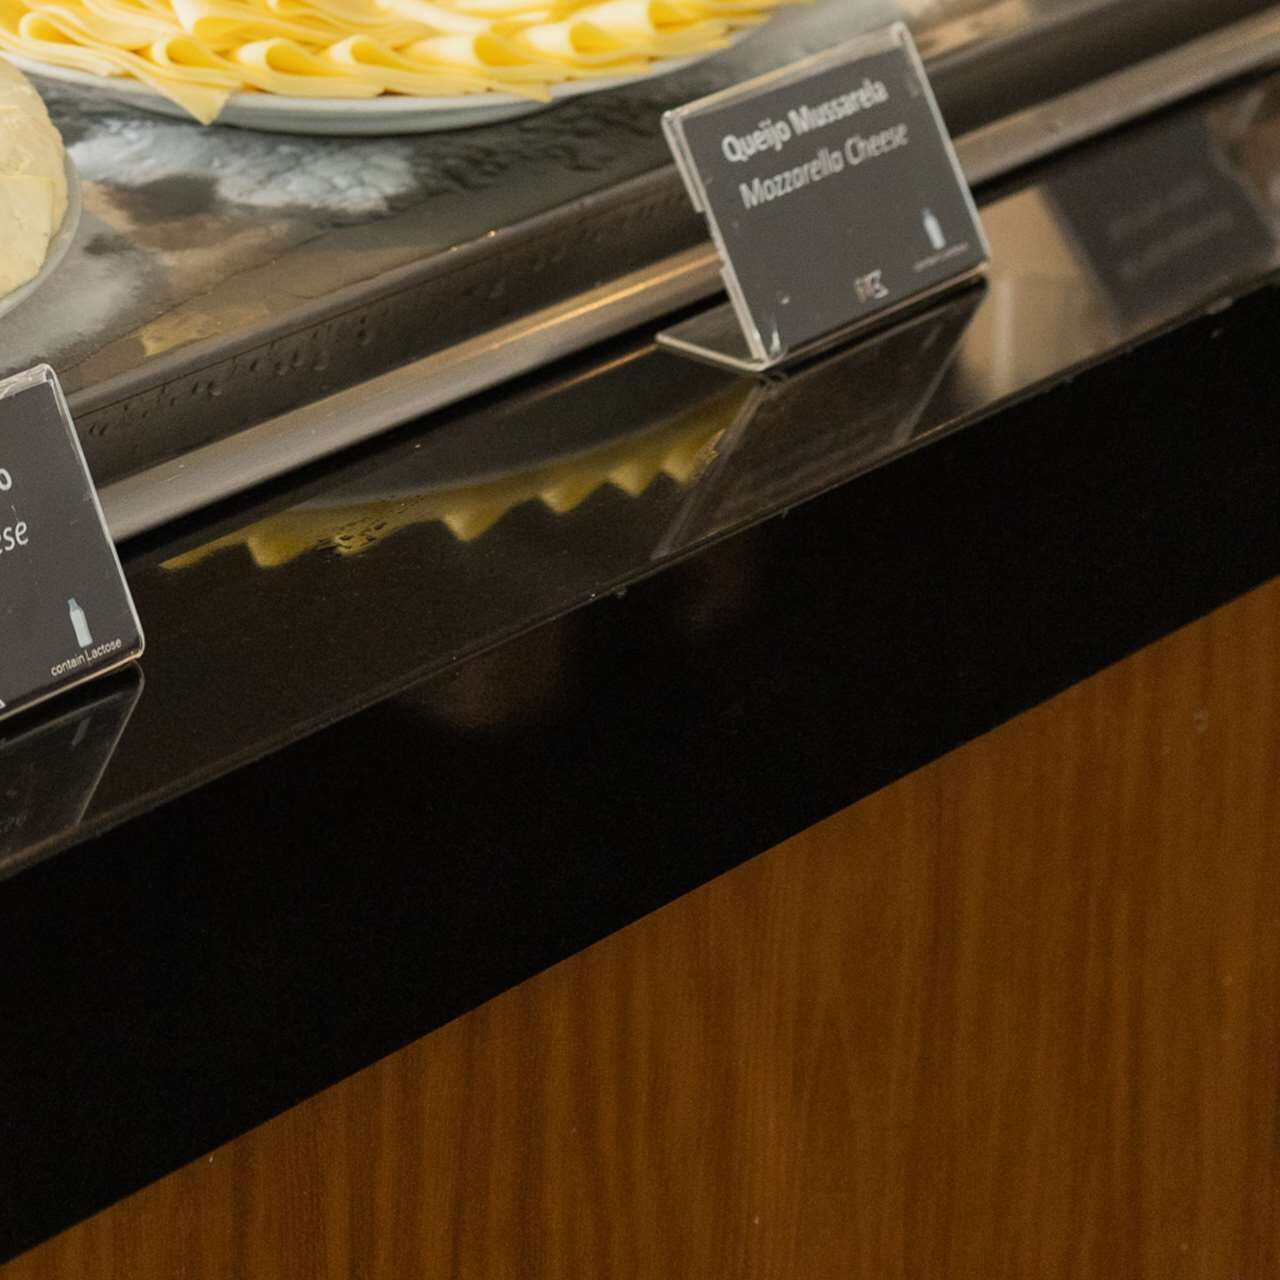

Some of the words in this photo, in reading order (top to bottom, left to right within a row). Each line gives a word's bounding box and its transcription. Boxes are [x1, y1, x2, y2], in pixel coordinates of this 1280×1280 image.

[721, 117, 792, 162] Queijo
[788, 78, 889, 136] Mussarela
[738, 146, 845, 210] Mozzarella
[845, 123, 910, 166] Cheese
[50, 655, 86, 677] contain
[85, 637, 123, 662] Lactose
